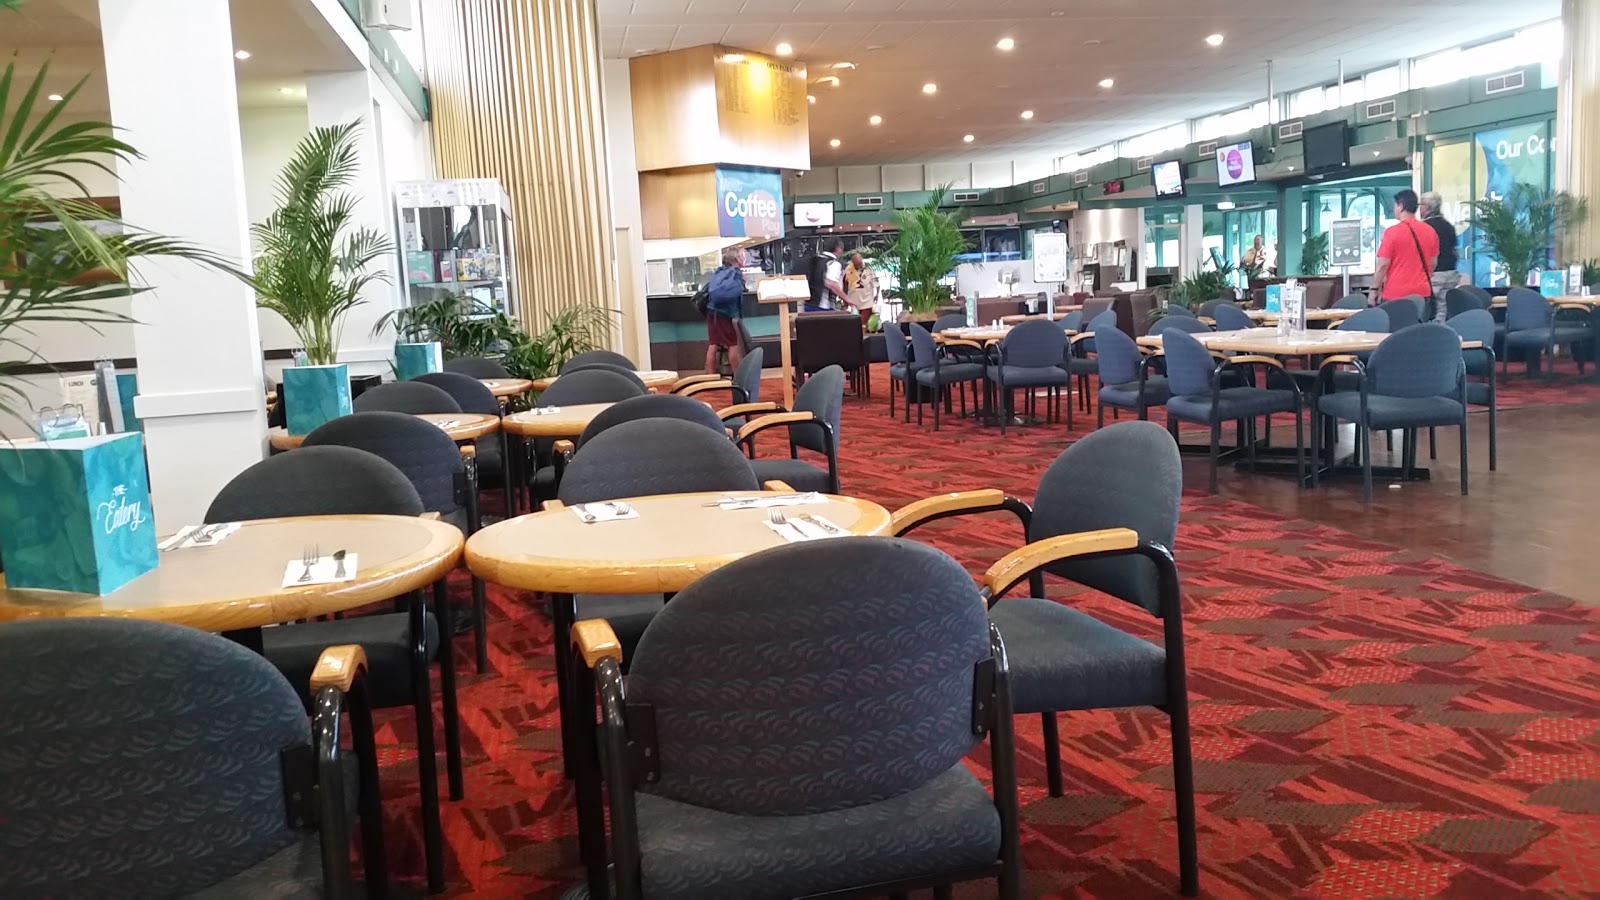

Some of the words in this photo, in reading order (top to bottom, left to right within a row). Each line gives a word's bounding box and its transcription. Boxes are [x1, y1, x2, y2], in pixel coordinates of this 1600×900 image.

[1496, 139, 1524, 160] Our
[724, 191, 777, 218] Coffee
[111, 484, 128, 497] THE
[96, 496, 147, 535] Eatery
